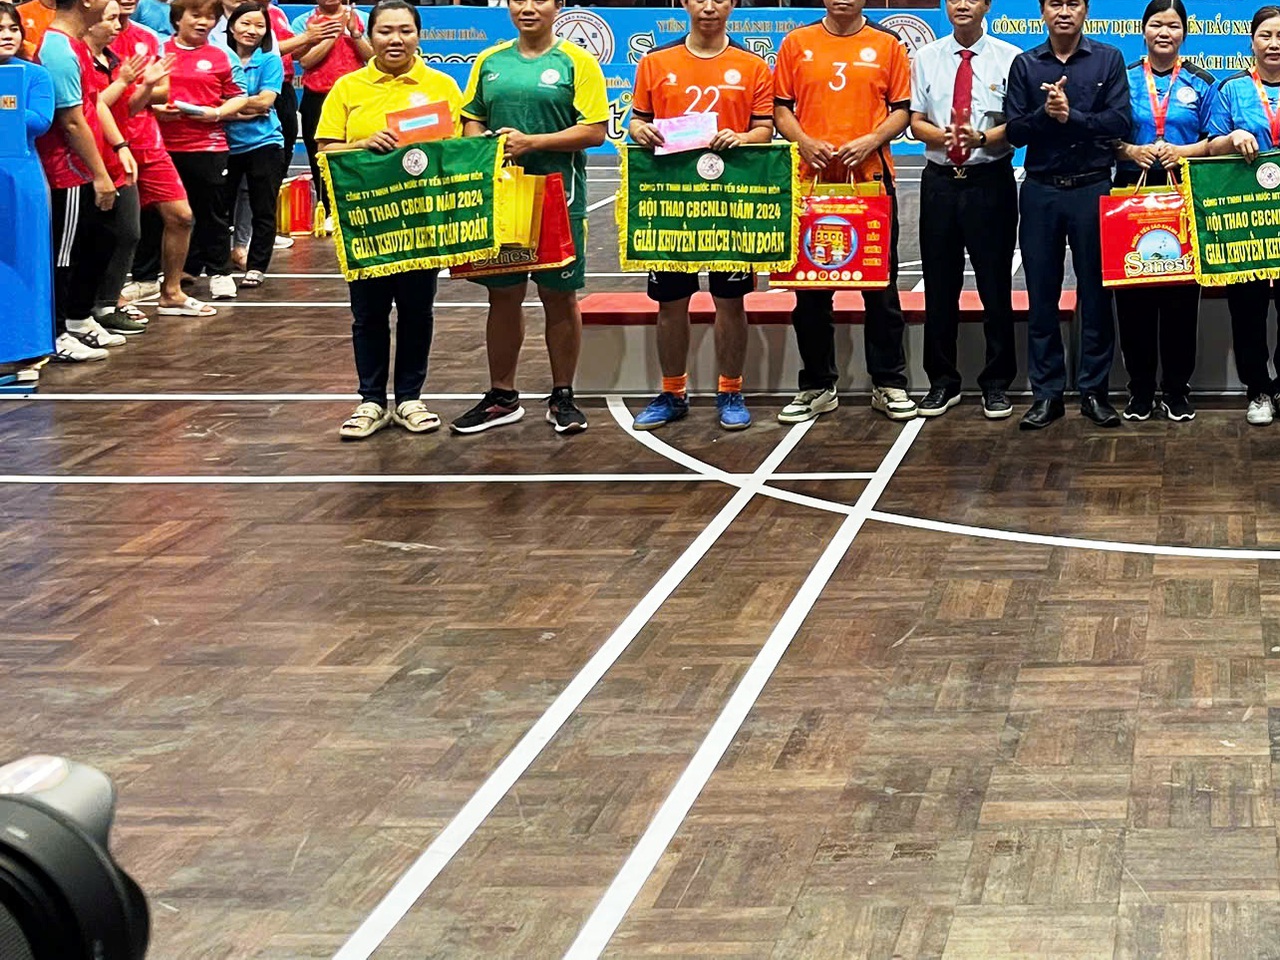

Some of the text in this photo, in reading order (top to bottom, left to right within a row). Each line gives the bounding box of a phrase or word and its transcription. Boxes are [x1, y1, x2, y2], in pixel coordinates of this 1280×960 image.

[992, 14, 1026, 34] CÔNG
[1029, 18, 1045, 34] TY
[1083, 18, 1109, 35] MTV
[1112, 19, 1142, 38] DỊCH
[828, 61, 847, 91] 3
[684, 85, 720, 116] 22
[369, 202, 400, 221] THAO
[458, 190, 484, 208] 2024
[638, 197, 657, 220] HỘI
[660, 200, 684, 217] THAO
[687, 200, 728, 218] CBCNLĐ
[756, 202, 781, 219] 2024
[1223, 211, 1249, 230] THAO
[698, 223, 730, 252] KHÍCH
[1124, 251, 1193, 278] Sanest
